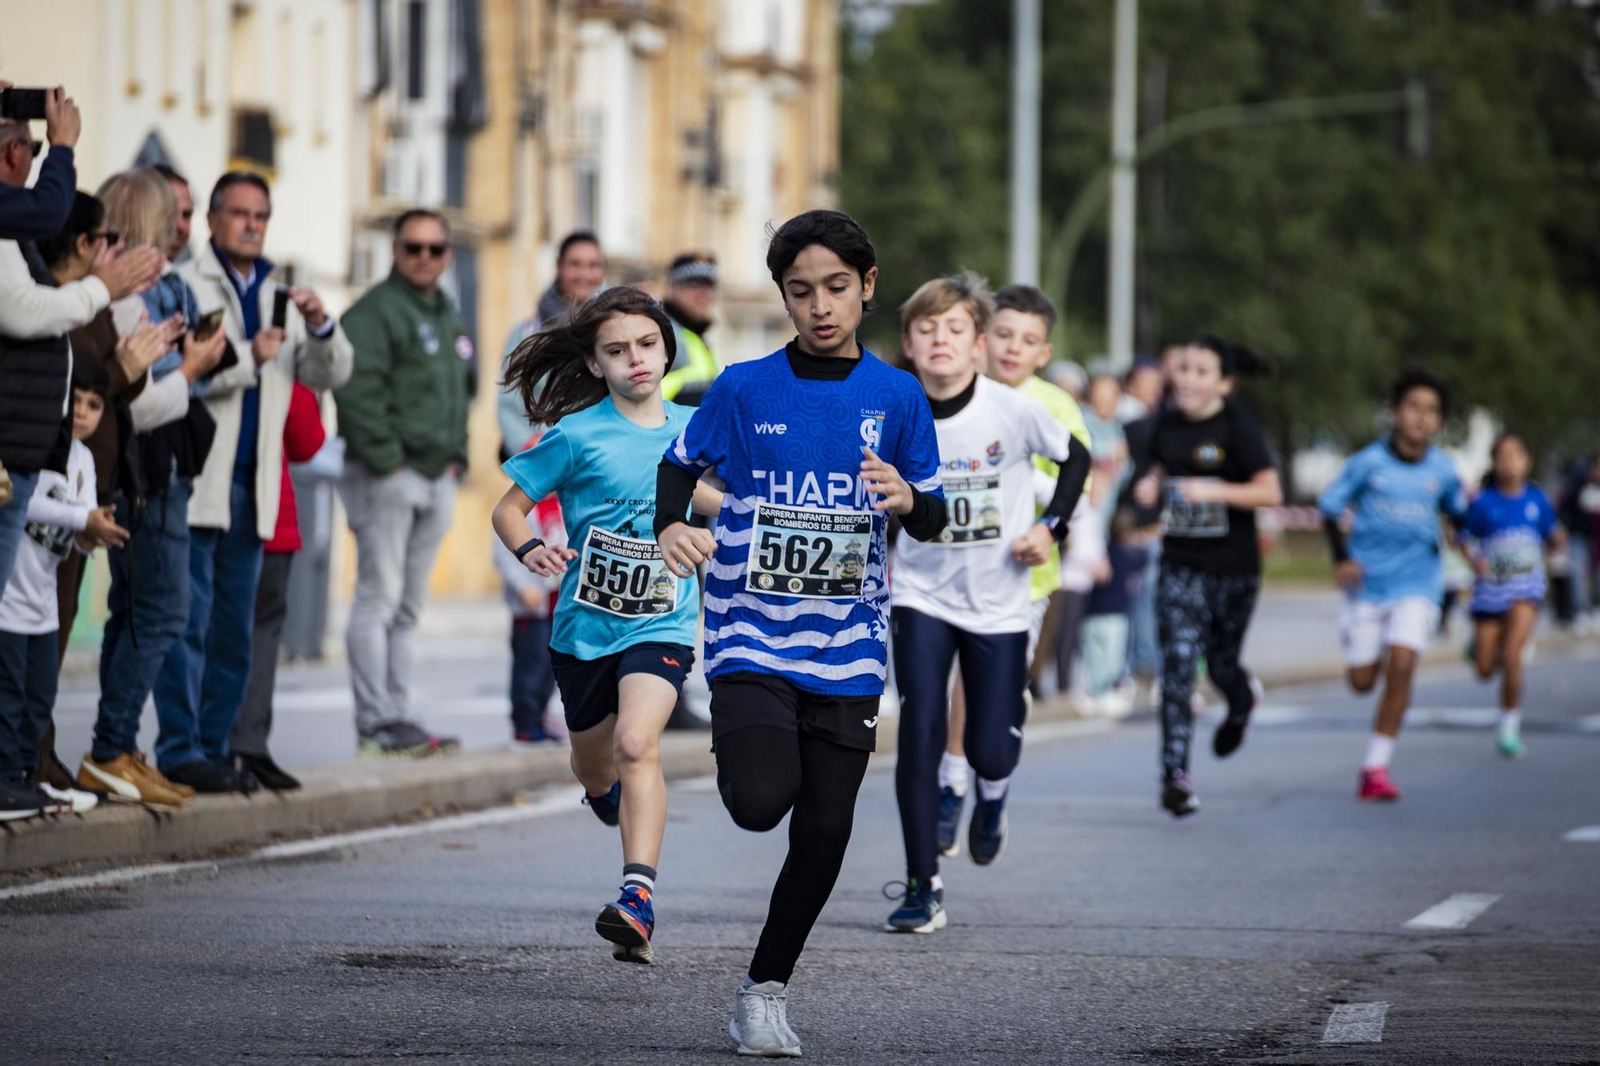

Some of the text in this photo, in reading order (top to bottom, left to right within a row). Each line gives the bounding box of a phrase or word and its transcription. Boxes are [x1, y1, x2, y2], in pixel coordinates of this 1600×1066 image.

[860, 408, 886, 416] CHAPIN
[754, 422, 787, 435] vive
[760, 507, 796, 519] CARRERA
[797, 513, 832, 523] INFANTIL
[773, 517, 855, 532] BOMBEROS DE JEREZ
[592, 531, 622, 547] CARRERA
[622, 542, 653, 552] INFANTIL
[601, 542, 642, 559] BOMBEROS
[758, 531, 833, 576] 562
[587, 552, 651, 598] 550
